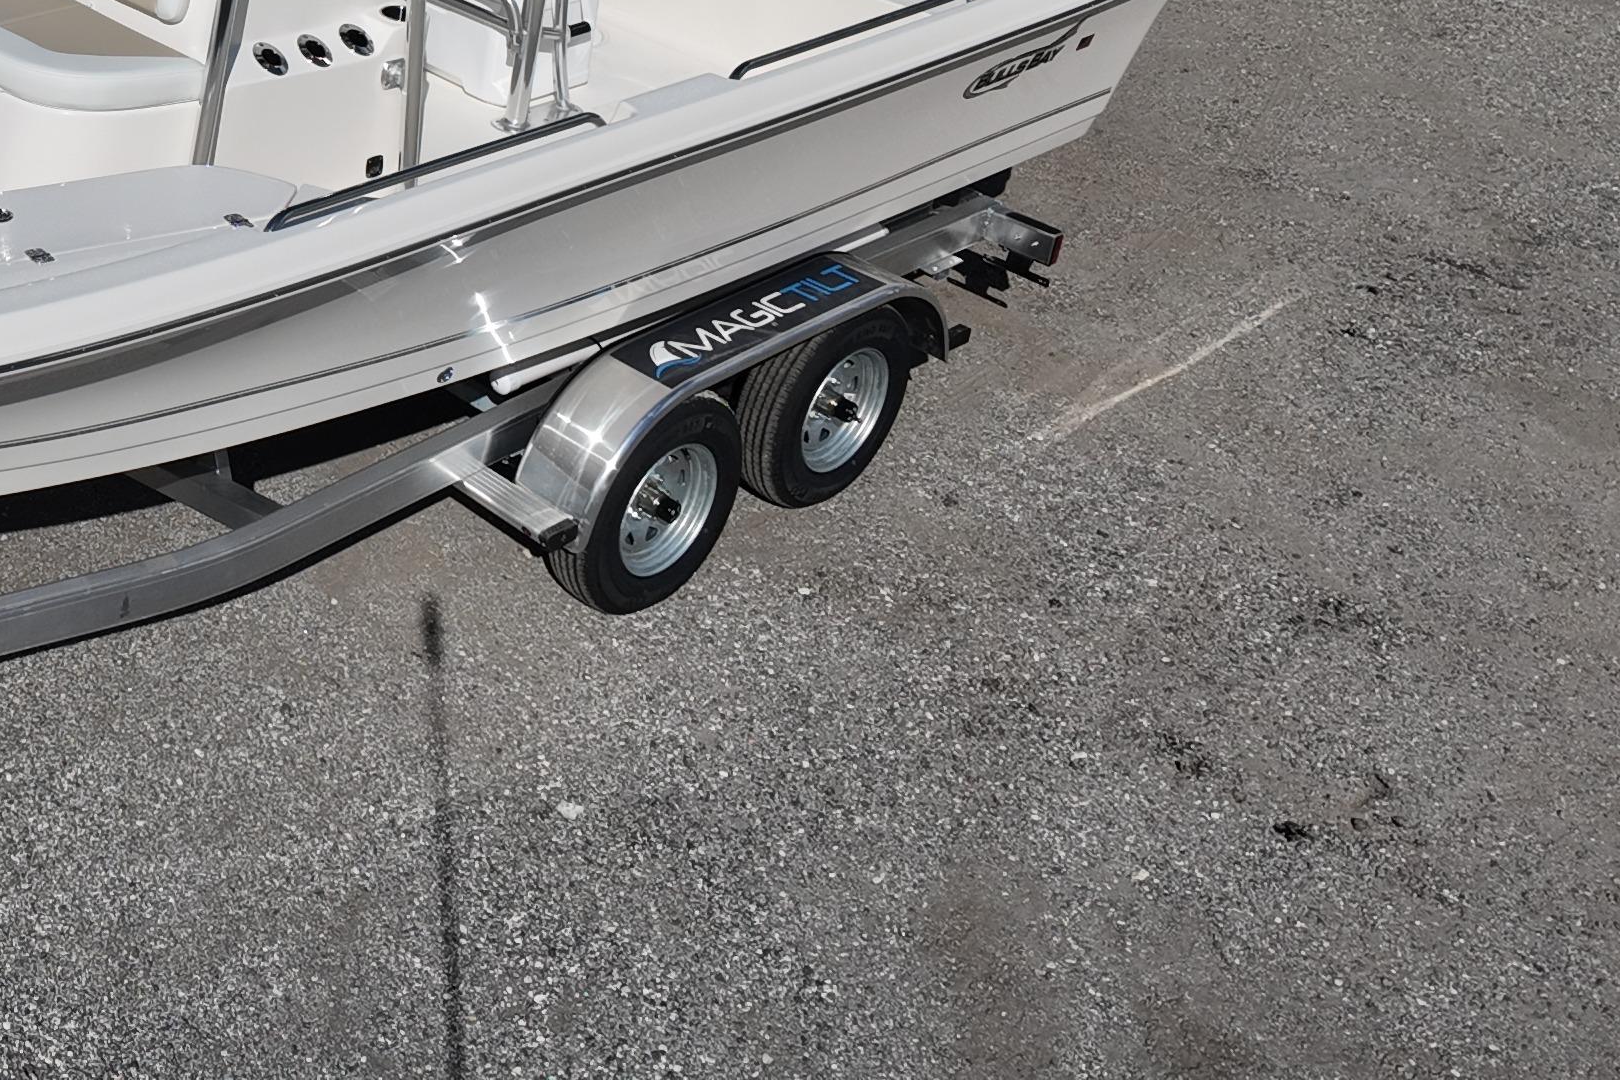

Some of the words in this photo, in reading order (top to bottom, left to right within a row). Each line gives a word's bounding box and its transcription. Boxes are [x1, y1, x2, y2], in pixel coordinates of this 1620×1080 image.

[972, 59, 1030, 92] BULLS
[1026, 45, 1065, 71] BAY
[667, 264, 860, 358] MAGICTILT
